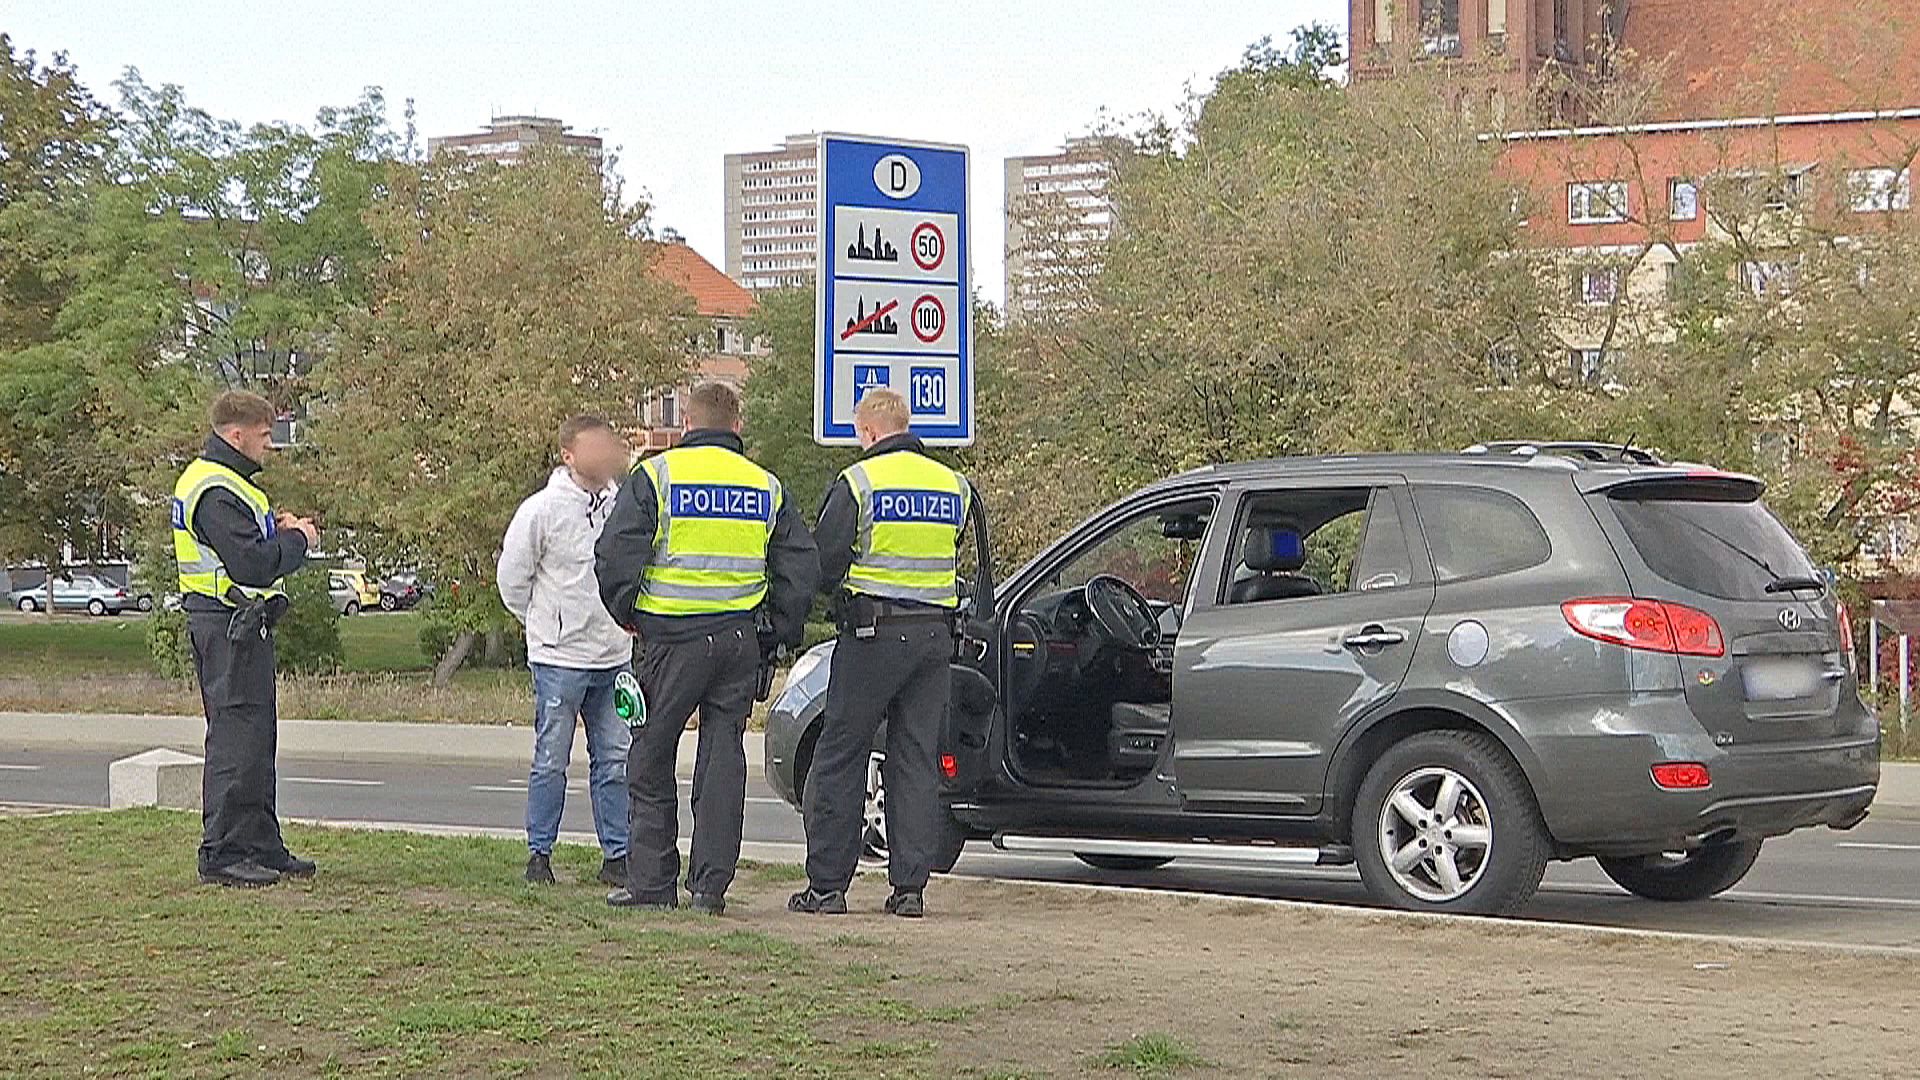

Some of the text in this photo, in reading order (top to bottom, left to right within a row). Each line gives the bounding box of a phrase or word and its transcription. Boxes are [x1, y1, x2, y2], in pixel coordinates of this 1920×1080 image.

[891, 162, 906, 192] D
[919, 236, 938, 257] 50
[918, 308, 939, 330] 100
[912, 375, 943, 407] 130
[679, 489, 763, 514] POLIZEI
[880, 495, 957, 518] POLIZEI
